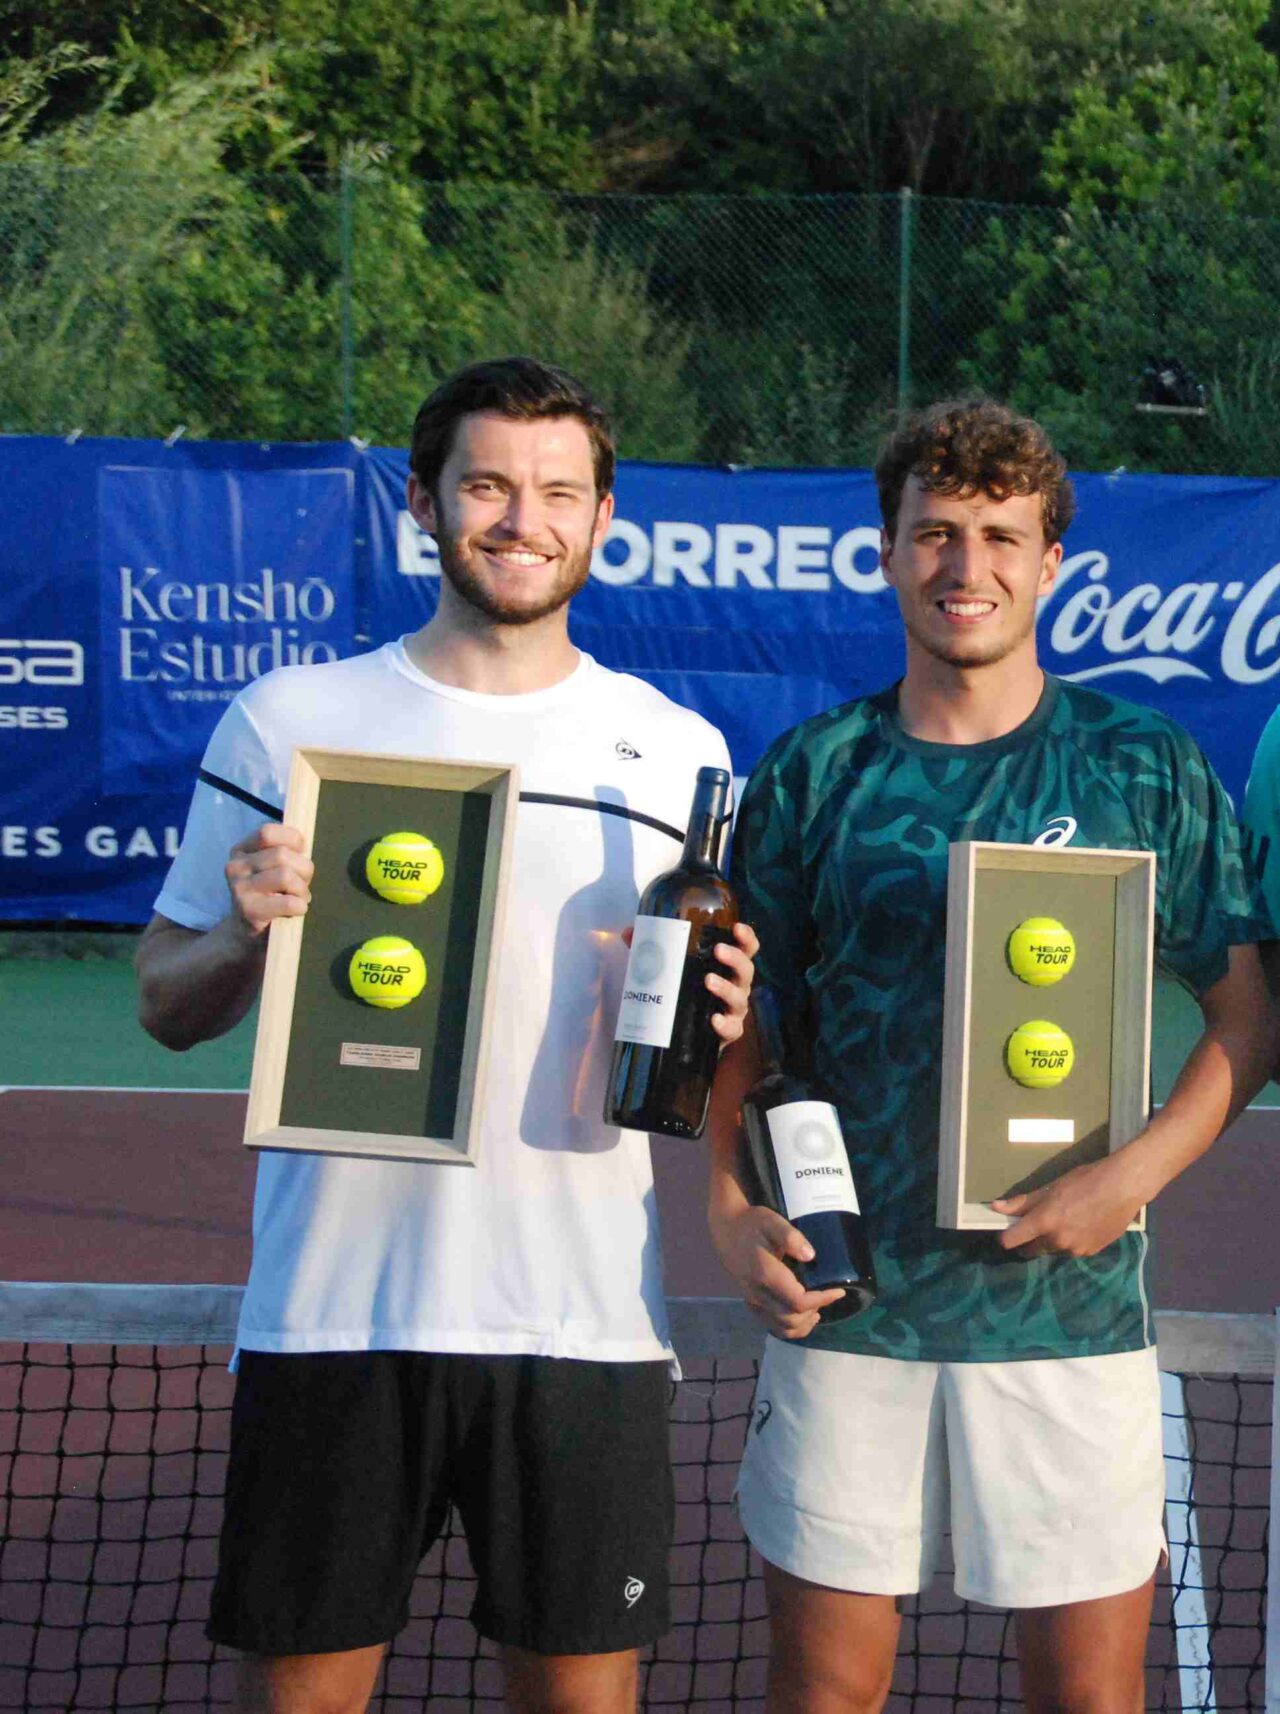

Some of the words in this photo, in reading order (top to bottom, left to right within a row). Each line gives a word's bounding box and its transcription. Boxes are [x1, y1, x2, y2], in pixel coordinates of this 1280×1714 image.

[397, 509, 442, 575] E
[588, 518, 890, 594] ORREO
[119, 627, 339, 682] Estudio
[377, 858, 428, 869] HEAD
[382, 867, 421, 882] TOUR
[1030, 945, 1071, 953] HEAD
[1036, 953, 1068, 965] TOUR
[357, 961, 411, 974] HEAD
[362, 971, 404, 986] TOUR
[1025, 1049, 1069, 1057] HEAD
[1031, 1057, 1065, 1069] TOUR
[795, 1166, 845, 1180] DONIENE
